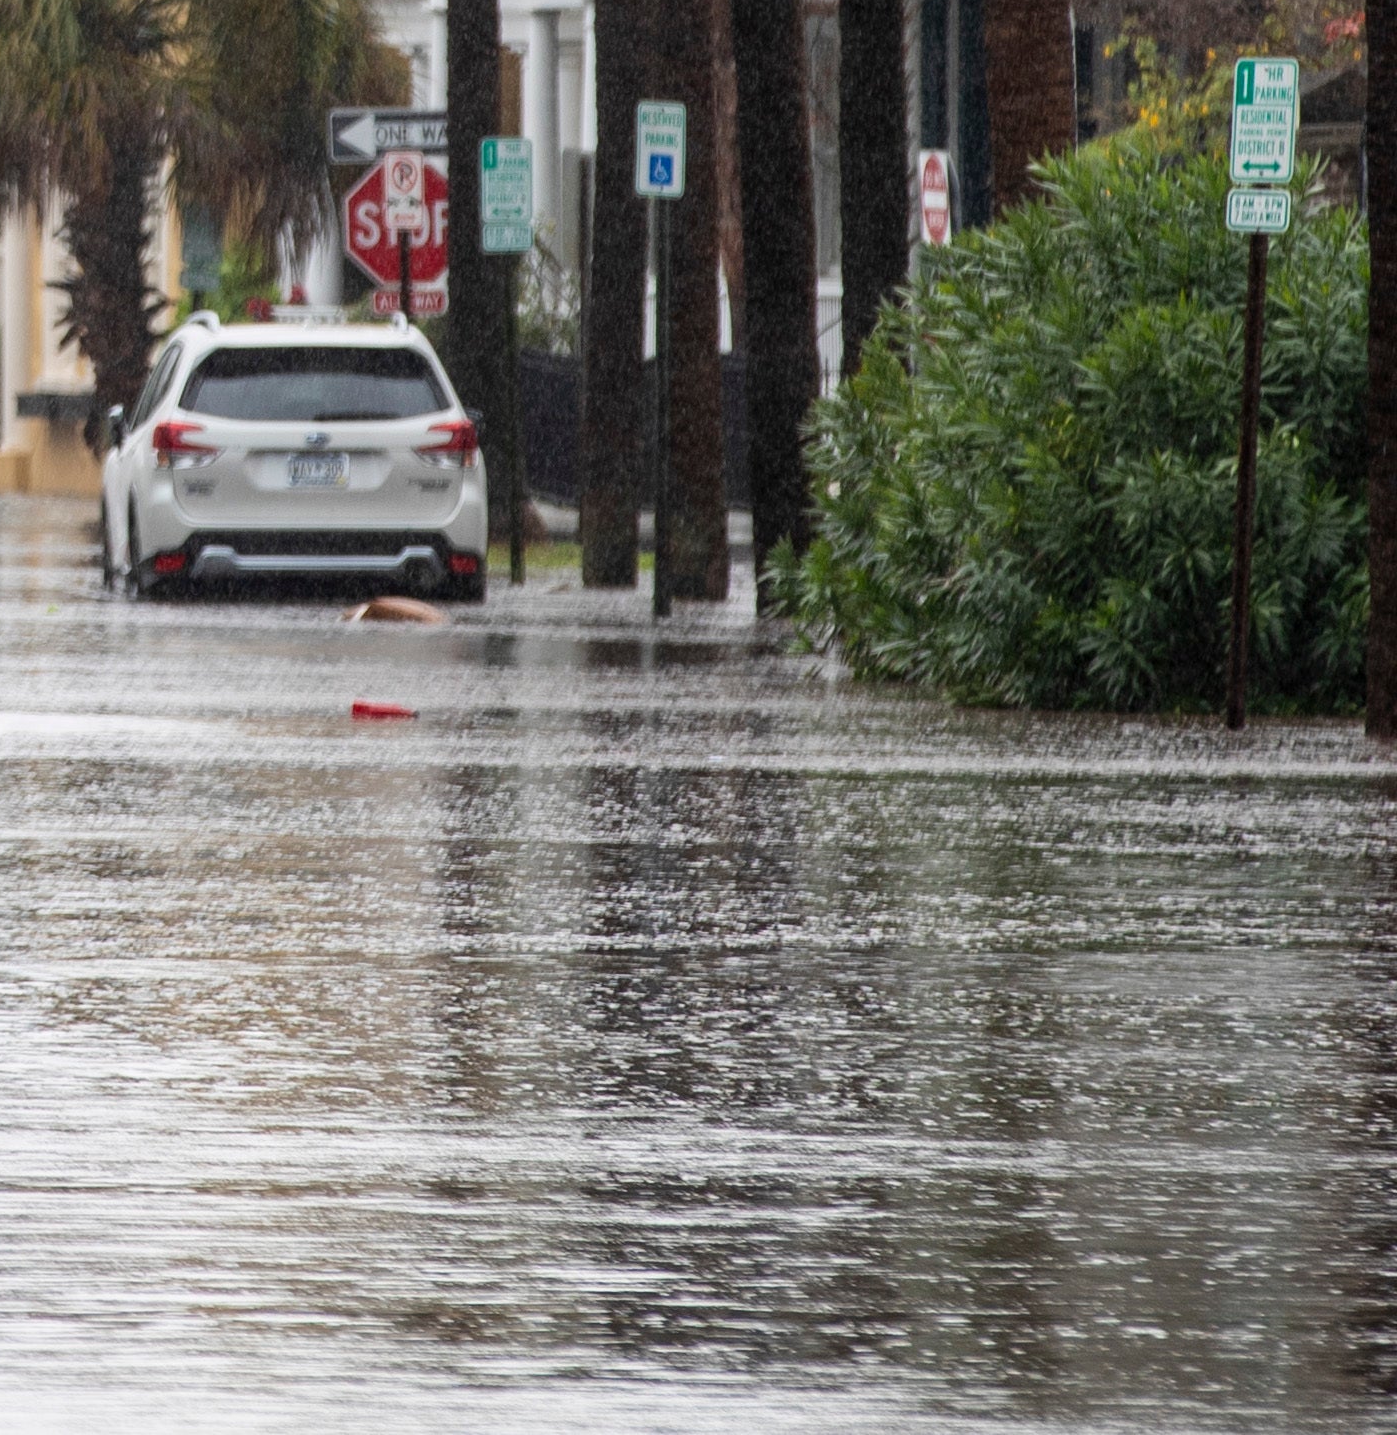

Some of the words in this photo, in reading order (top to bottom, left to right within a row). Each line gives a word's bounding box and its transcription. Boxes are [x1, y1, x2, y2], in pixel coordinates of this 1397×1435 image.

[1268, 67, 1284, 82] HR
[1242, 68, 1249, 98] 1
[1255, 86, 1292, 101] PARKING
[641, 111, 683, 127] RESERVED
[1240, 110, 1287, 125] RESIDENTIAL
[375, 126, 408, 144] ONE
[422, 126, 448, 144] WA
[645, 132, 679, 148] PARKING
[1238, 141, 1275, 156] DISTRICT
[413, 292, 442, 309] WAY
